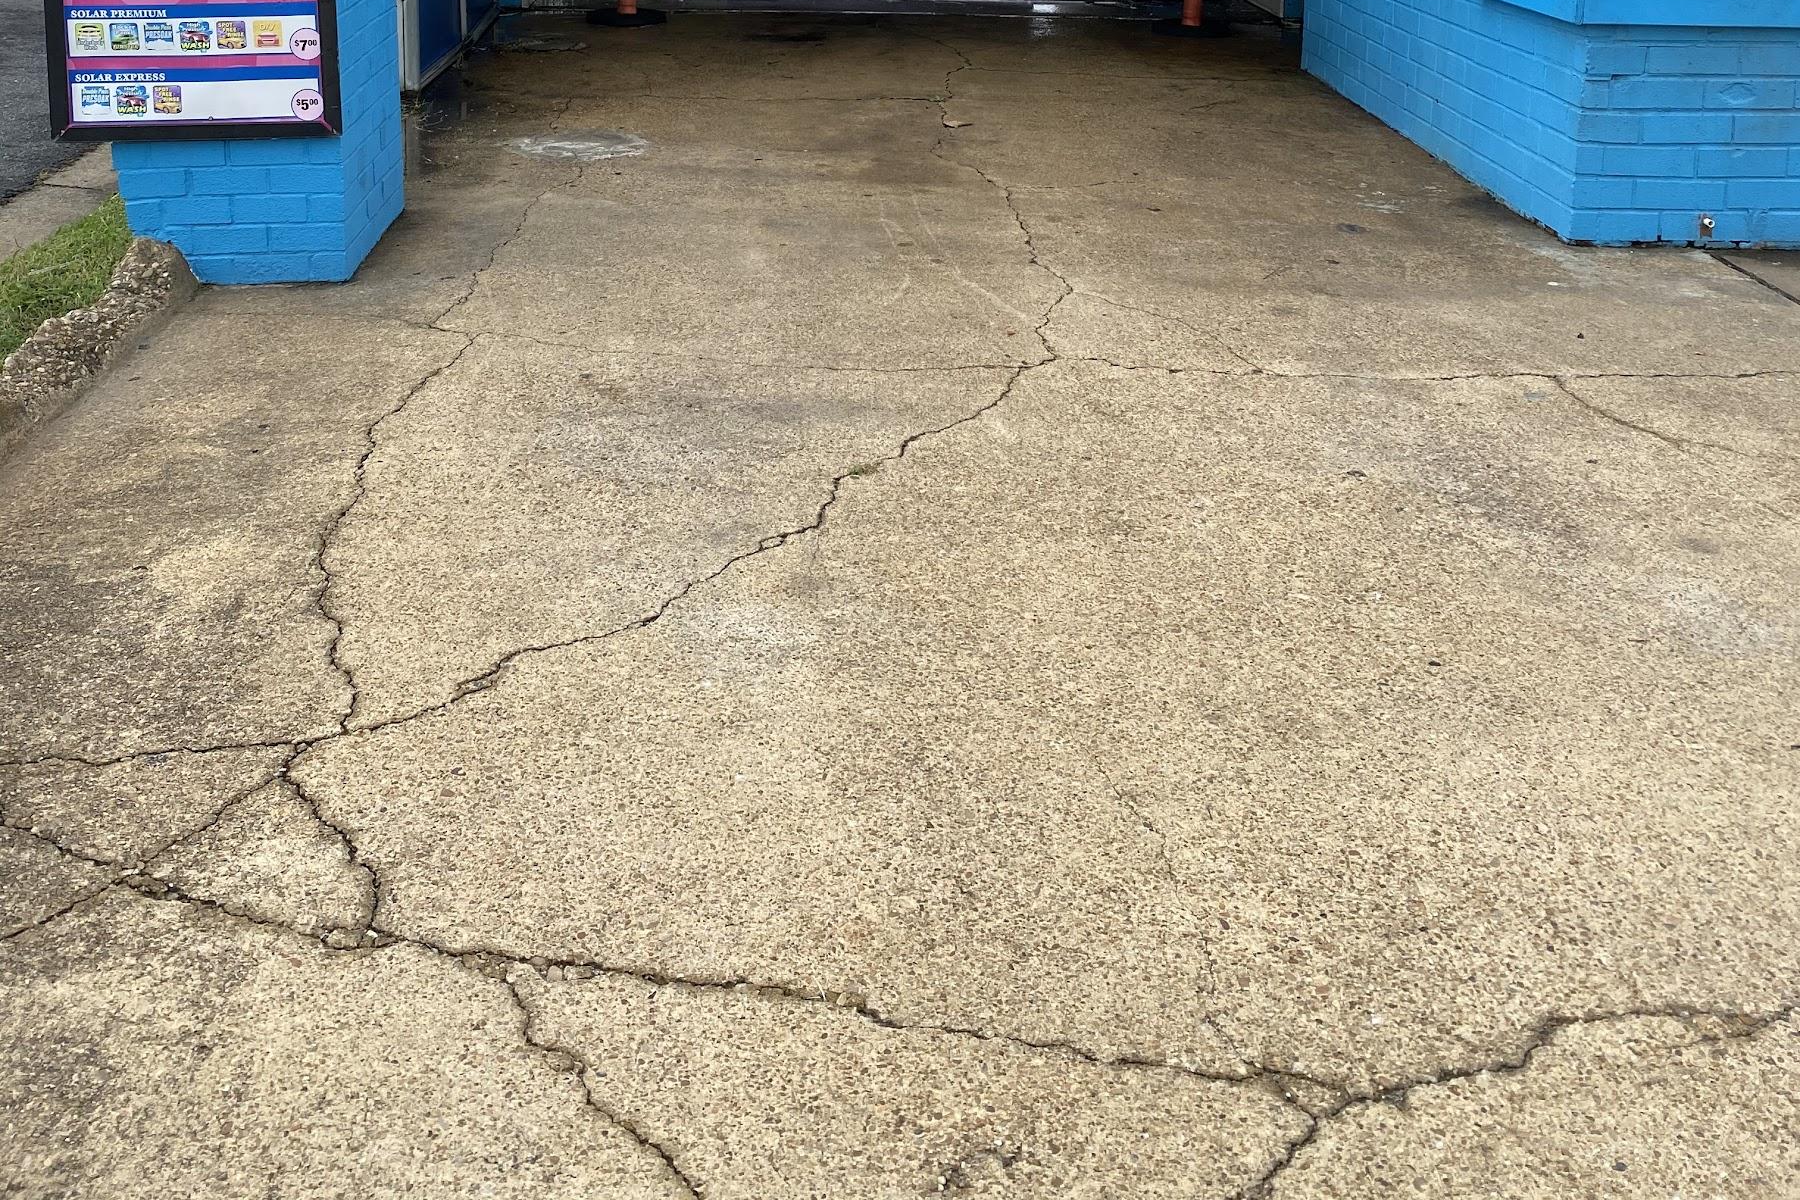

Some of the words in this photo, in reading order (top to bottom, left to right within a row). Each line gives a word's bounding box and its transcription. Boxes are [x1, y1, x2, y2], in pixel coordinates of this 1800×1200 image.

[70, 9, 109, 18] SOLAR
[111, 9, 167, 18] PREMIUM
[75, 73, 112, 82] SOLAR
[115, 72, 166, 82] EXPRESS
